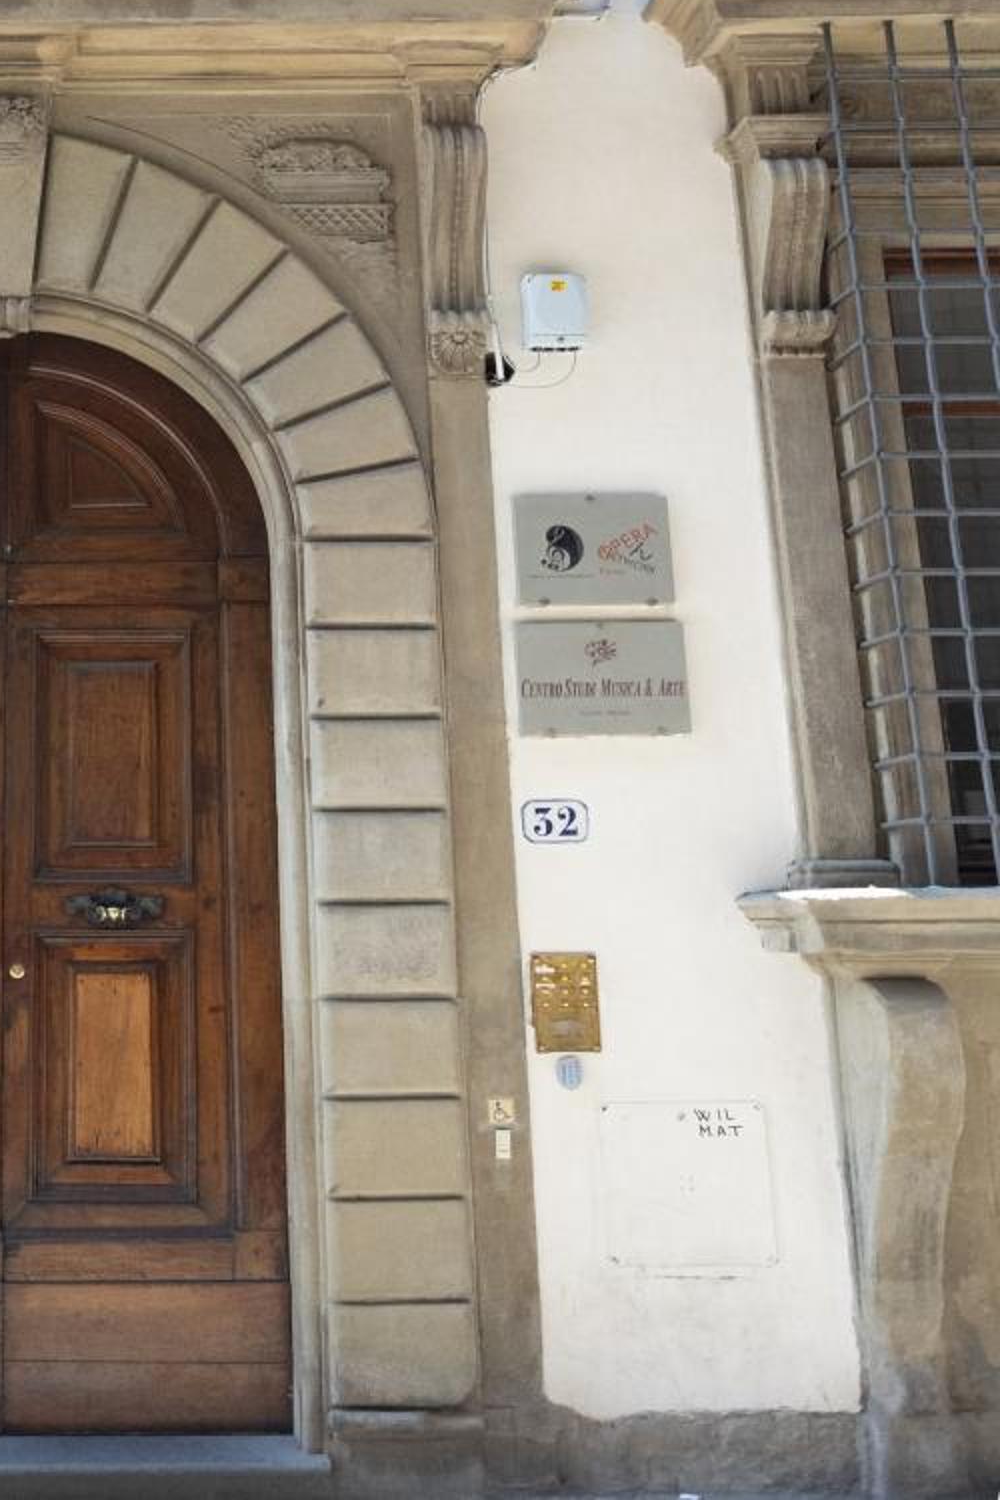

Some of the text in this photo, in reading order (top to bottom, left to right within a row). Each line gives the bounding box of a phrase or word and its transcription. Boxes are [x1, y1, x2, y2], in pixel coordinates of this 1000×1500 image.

[520, 678, 562, 698] CENTRO
[565, 677, 597, 697] STUDI
[601, 678, 641, 697] MUSICA
[658, 678, 686, 698] ARTE
[533, 805, 579, 837] 32
[693, 1108, 736, 1122] WIL
[698, 1124, 744, 1137] MAT
